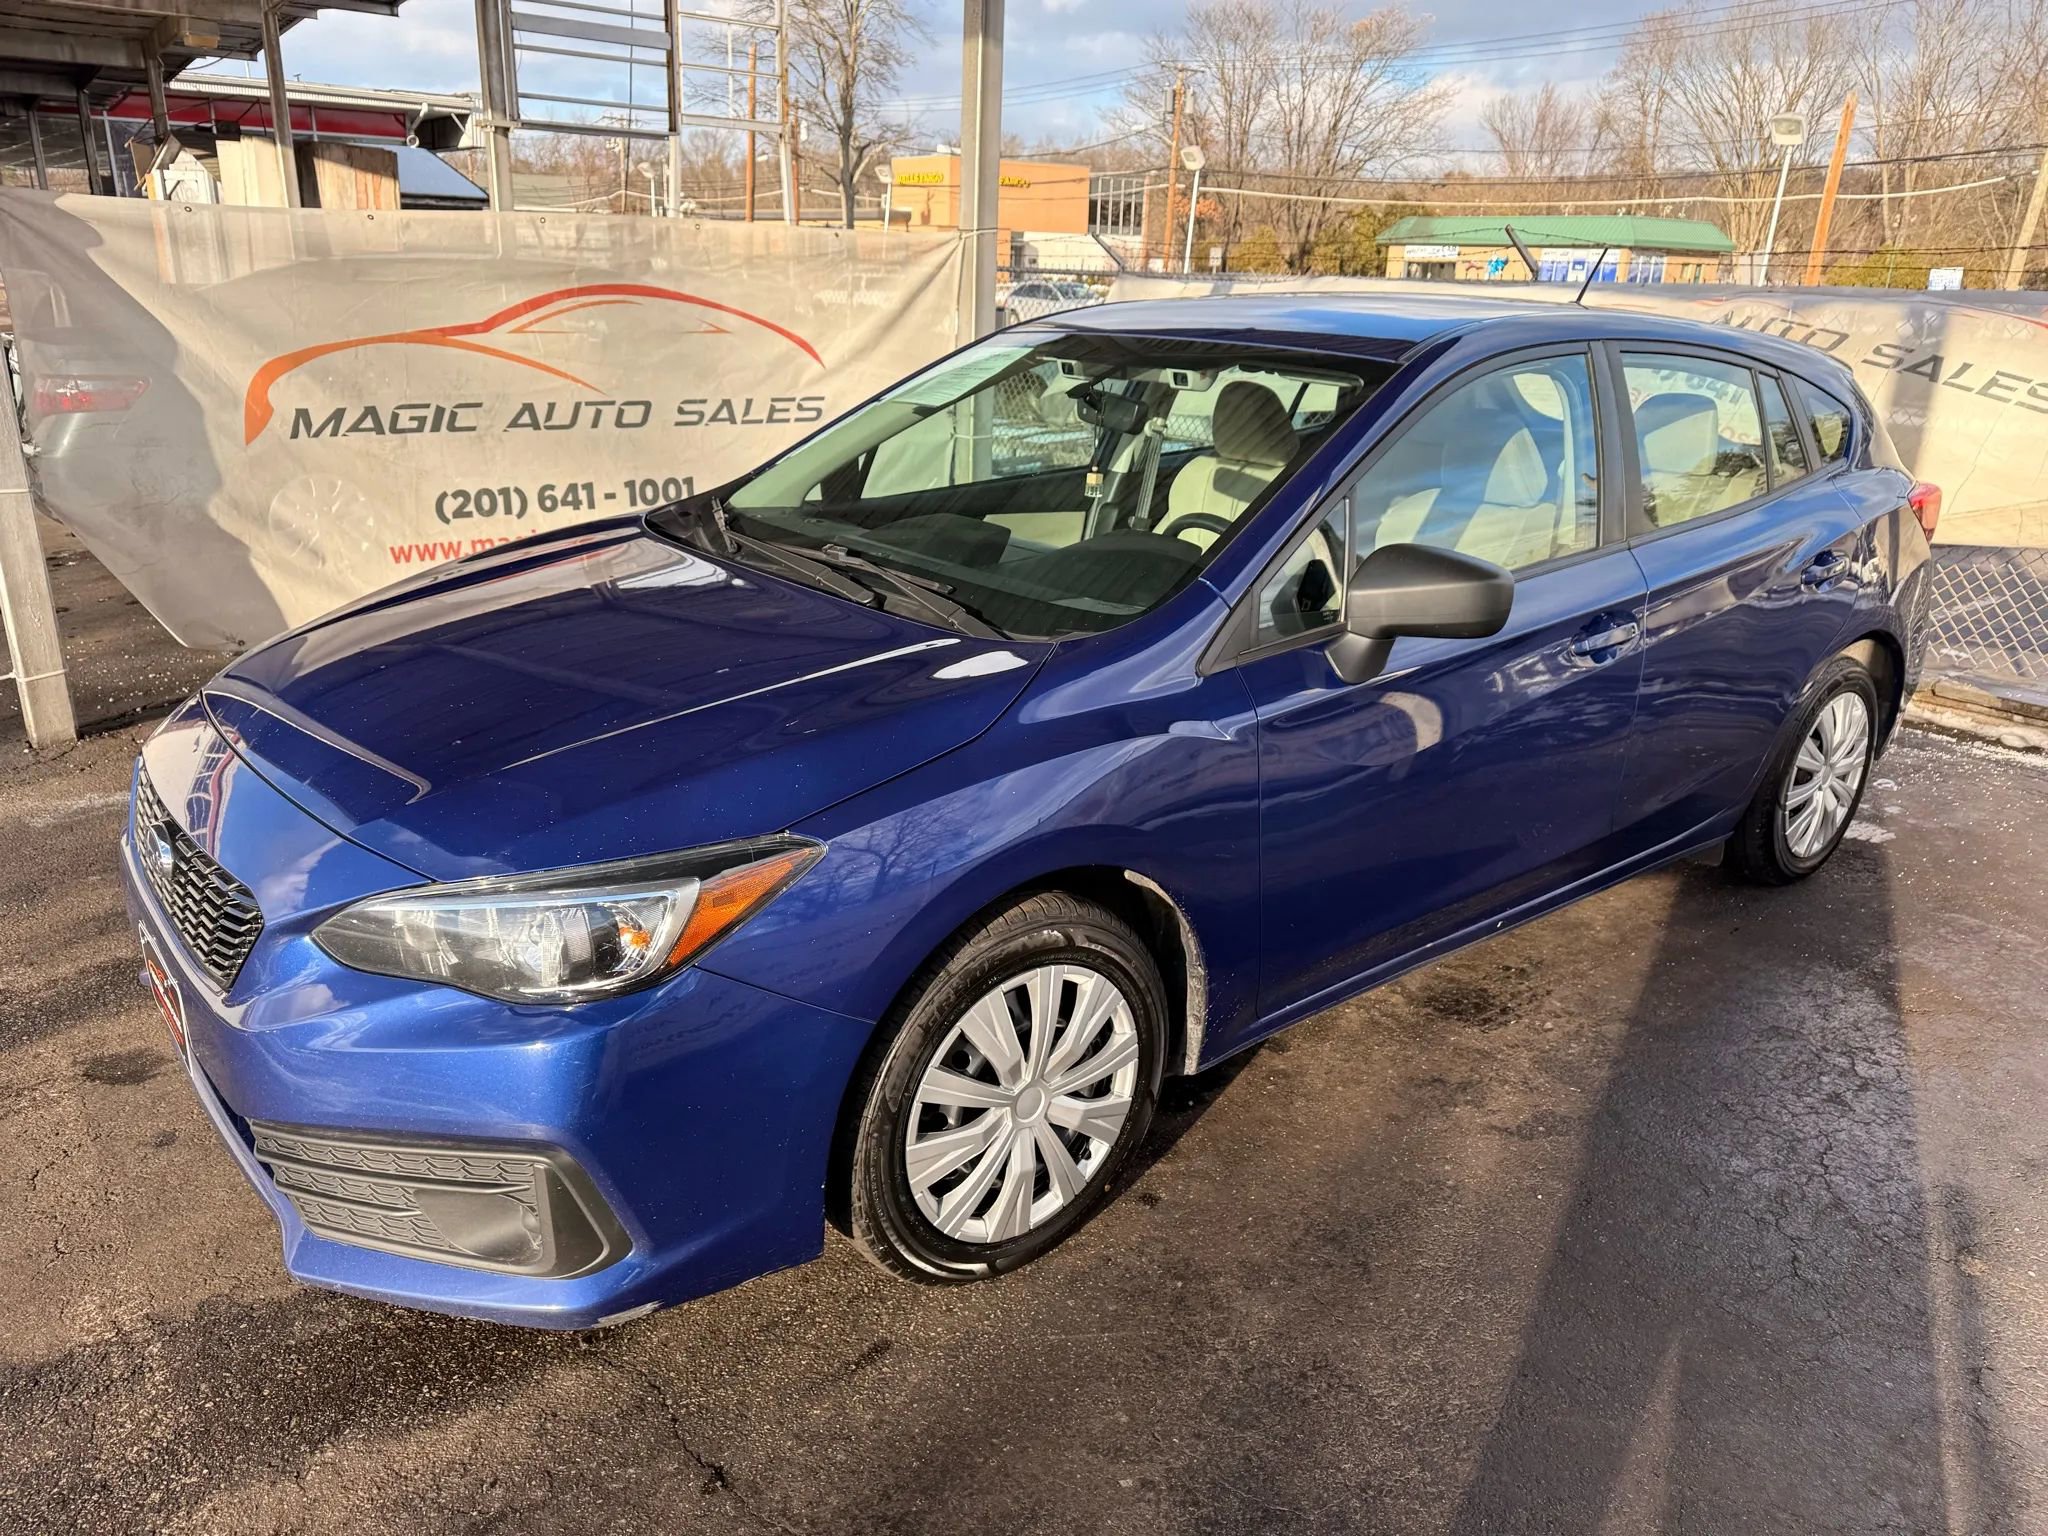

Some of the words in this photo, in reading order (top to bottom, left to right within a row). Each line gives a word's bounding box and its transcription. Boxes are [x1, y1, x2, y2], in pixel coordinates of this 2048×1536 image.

[289, 402, 484, 440] MAGIC
[503, 399, 653, 433] AUTO
[674, 396, 826, 427] SALES
[435, 486, 529, 525] (201)
[537, 481, 596, 513] 641
[604, 491, 617, 501] -
[624, 475, 695, 508] 1001
